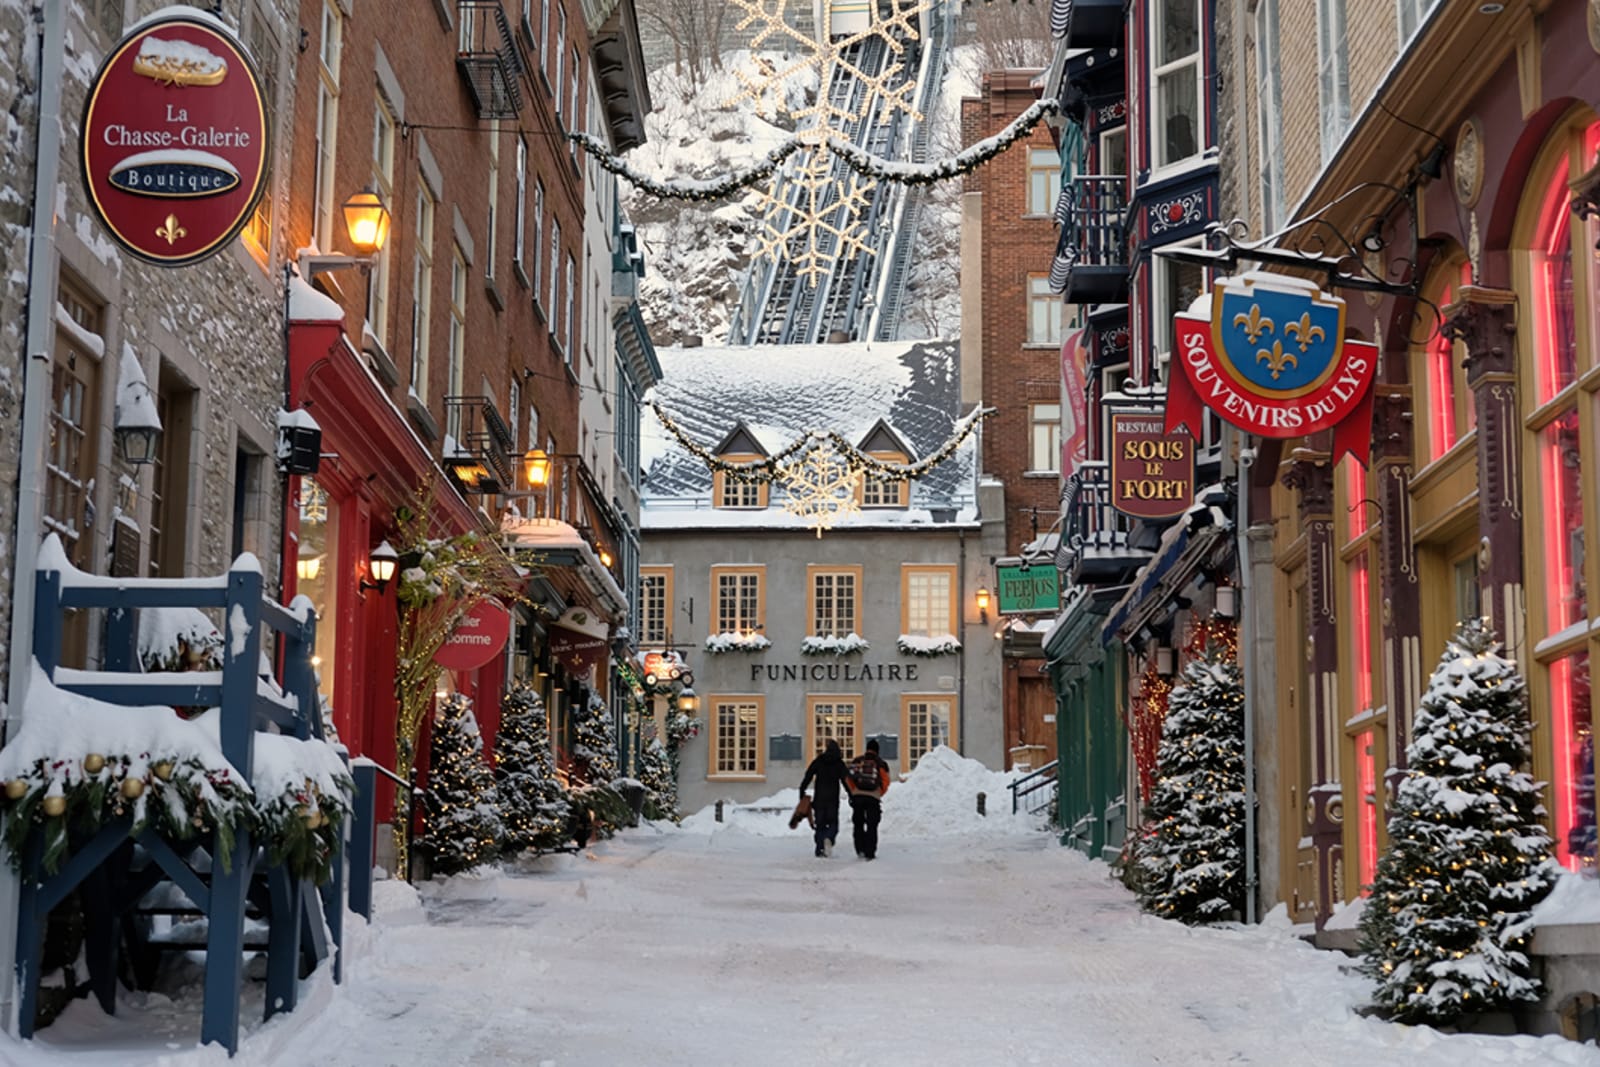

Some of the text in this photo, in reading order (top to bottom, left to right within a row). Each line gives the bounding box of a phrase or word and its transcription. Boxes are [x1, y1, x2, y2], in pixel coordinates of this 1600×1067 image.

[166, 104, 188, 122] La
[104, 124, 250, 148] Chasse-Galerie
[128, 170, 222, 191] Boutique
[1183, 332, 1368, 428] SOUVENIRS DU LYS
[1124, 440, 1184, 460] SOUS
[1145, 462, 1164, 476] LE
[1120, 479, 1188, 500] FORT
[750, 663, 919, 682] FUNICULAIRE
